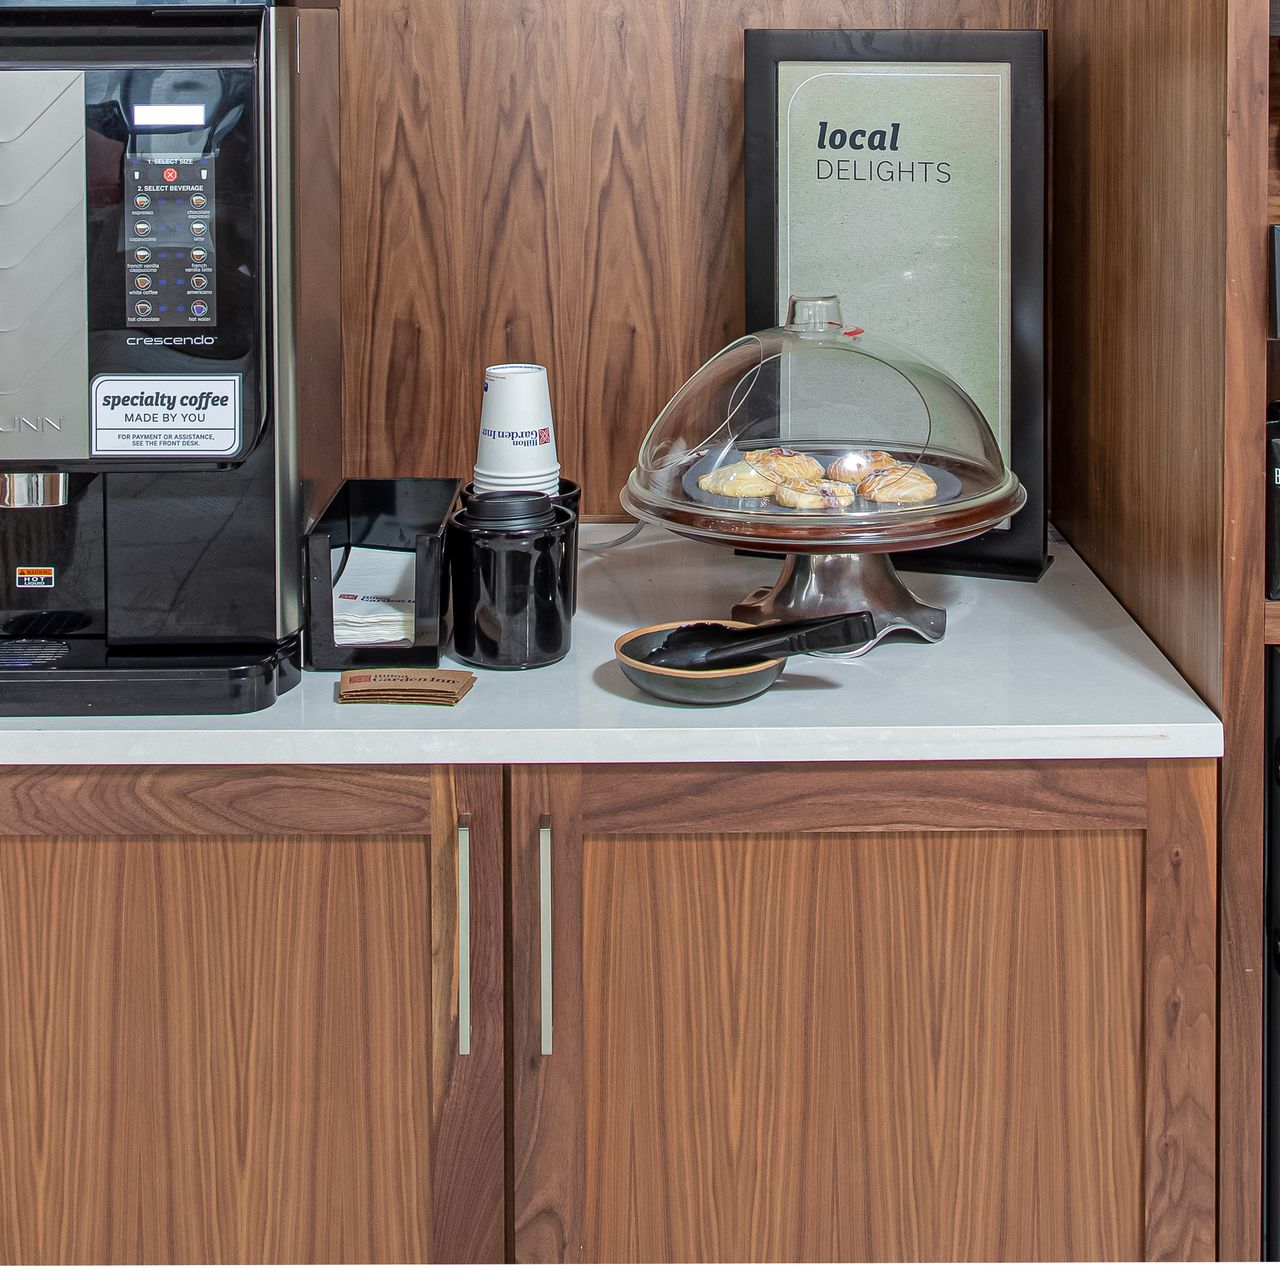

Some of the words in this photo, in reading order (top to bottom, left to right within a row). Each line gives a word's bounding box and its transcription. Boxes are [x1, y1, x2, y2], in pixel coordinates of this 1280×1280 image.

[817, 121, 900, 151] local
[816, 159, 952, 183] DELIGHTS
[126, 335, 215, 346] crescendo
[102, 391, 177, 410] specialty
[180, 392, 229, 410] coffee
[124, 413, 159, 423] MADE
[162, 413, 178, 423] BY
[181, 413, 206, 423] YOU
[497, 429, 538, 441] Garden
[513, 439, 538, 447] Hilton
